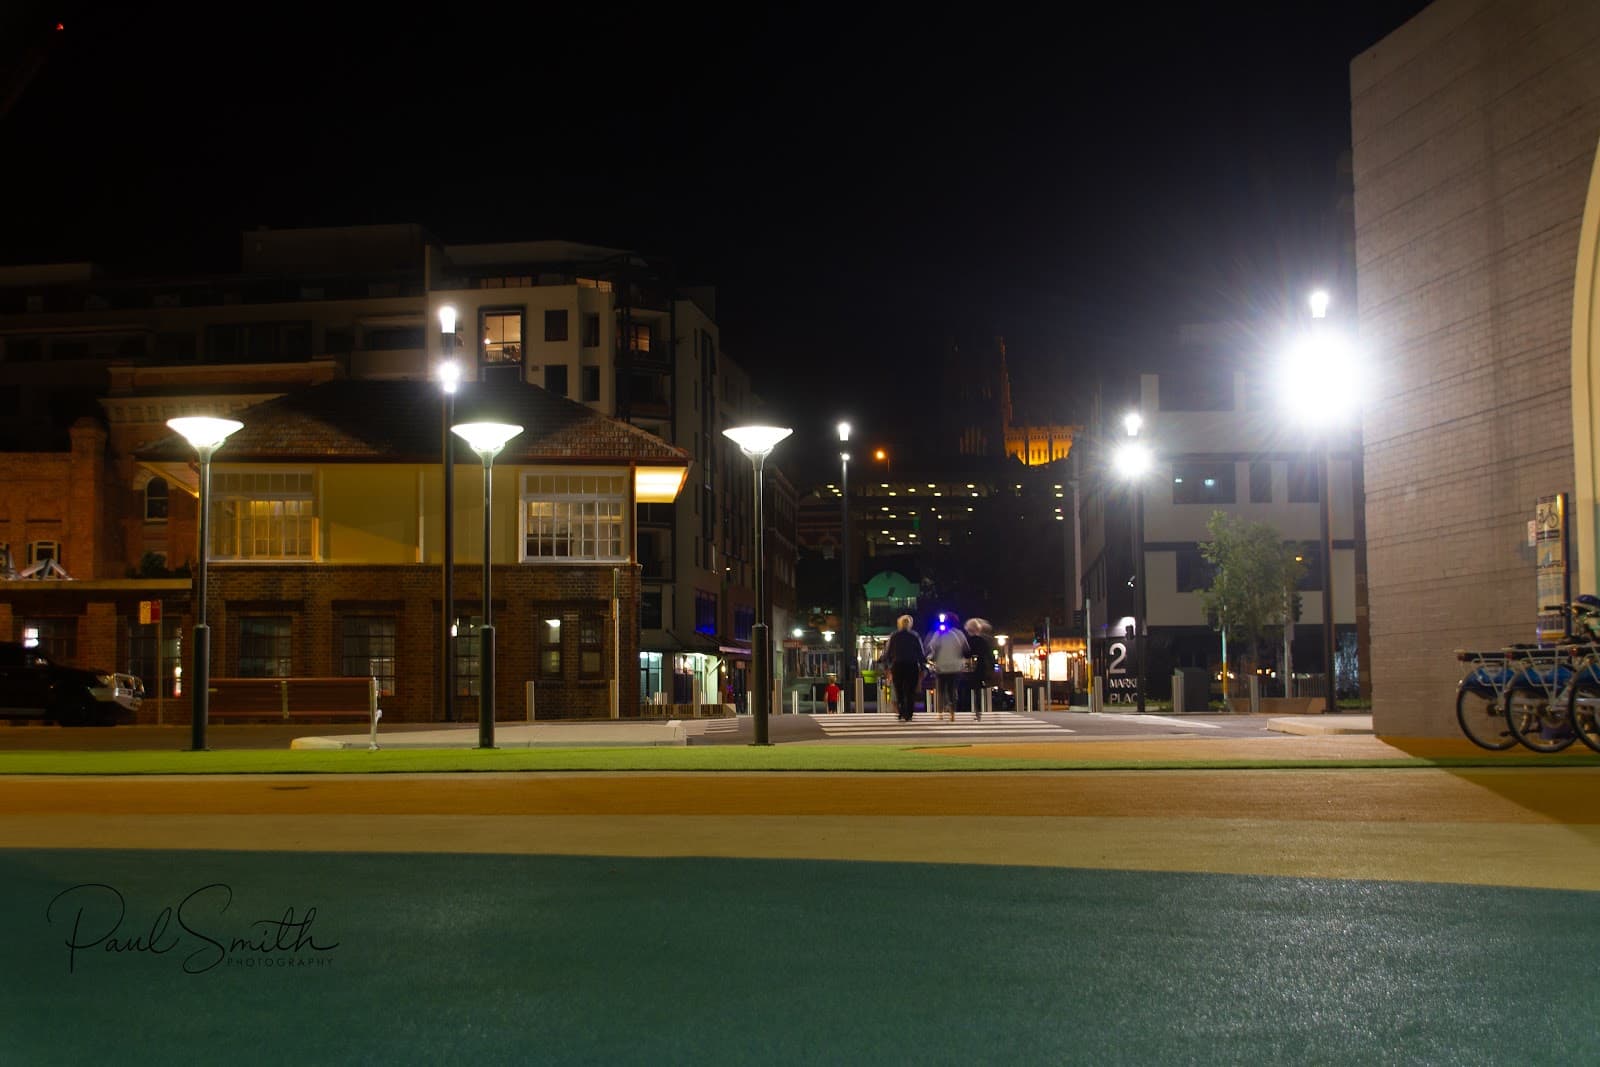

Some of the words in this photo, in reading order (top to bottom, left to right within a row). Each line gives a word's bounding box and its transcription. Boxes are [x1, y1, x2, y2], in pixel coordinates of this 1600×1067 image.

[1109, 642, 1127, 674] 2
[1109, 678, 1145, 689] MARK
[1110, 692, 1146, 704] PLAC
